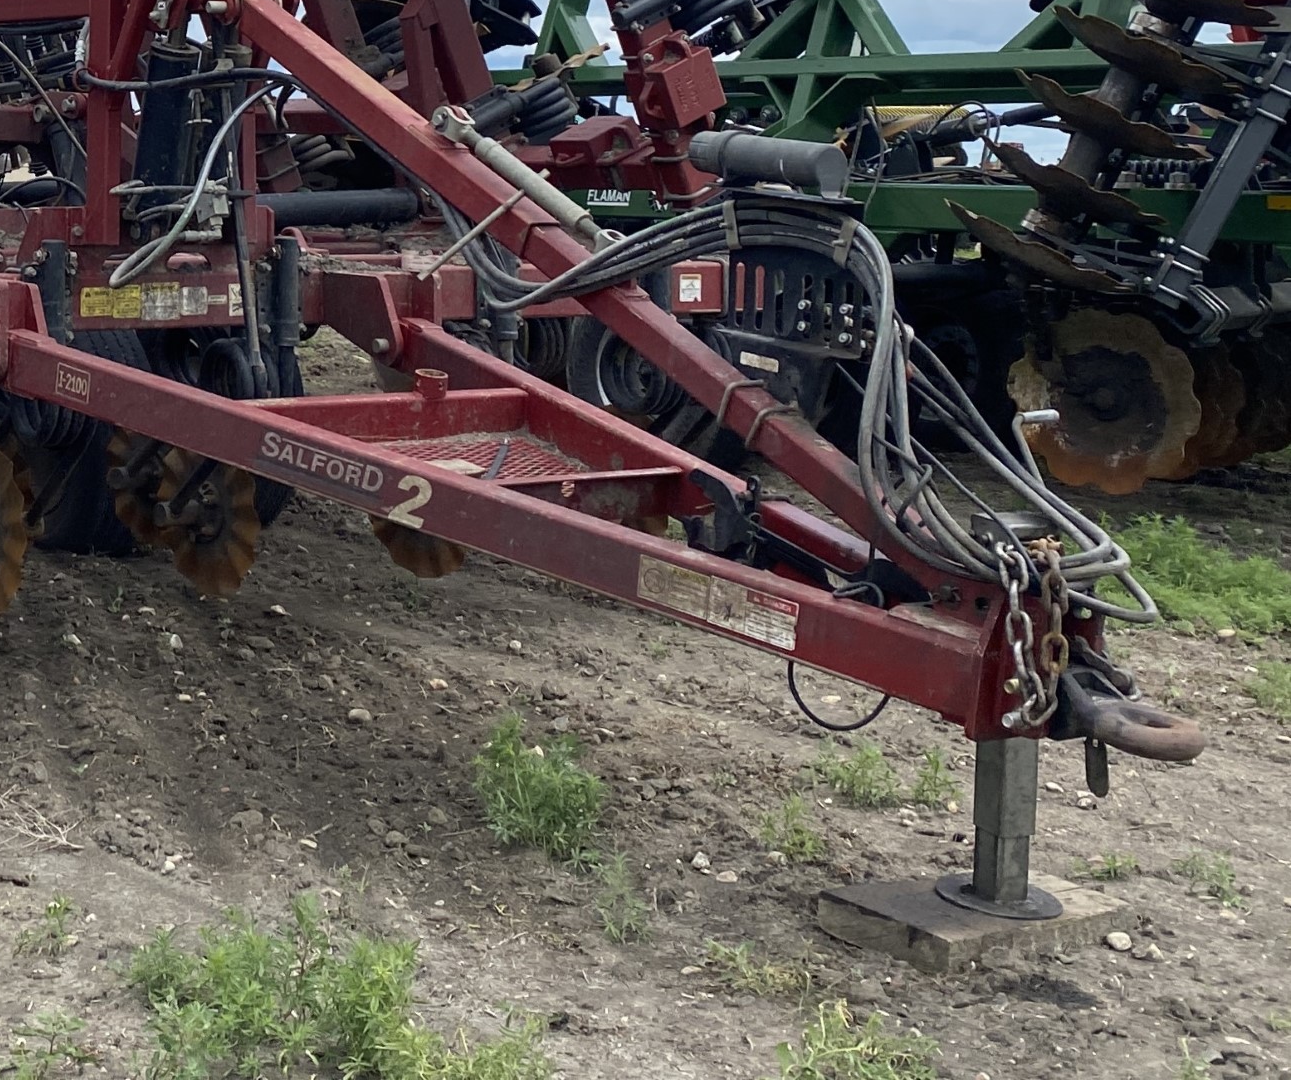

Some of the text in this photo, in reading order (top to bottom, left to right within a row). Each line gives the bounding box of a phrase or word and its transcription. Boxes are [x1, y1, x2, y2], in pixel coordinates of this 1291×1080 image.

[587, 188, 631, 202] FLAMAN
[261, 431, 384, 492] SALFORD
[388, 475, 433, 529] 2
